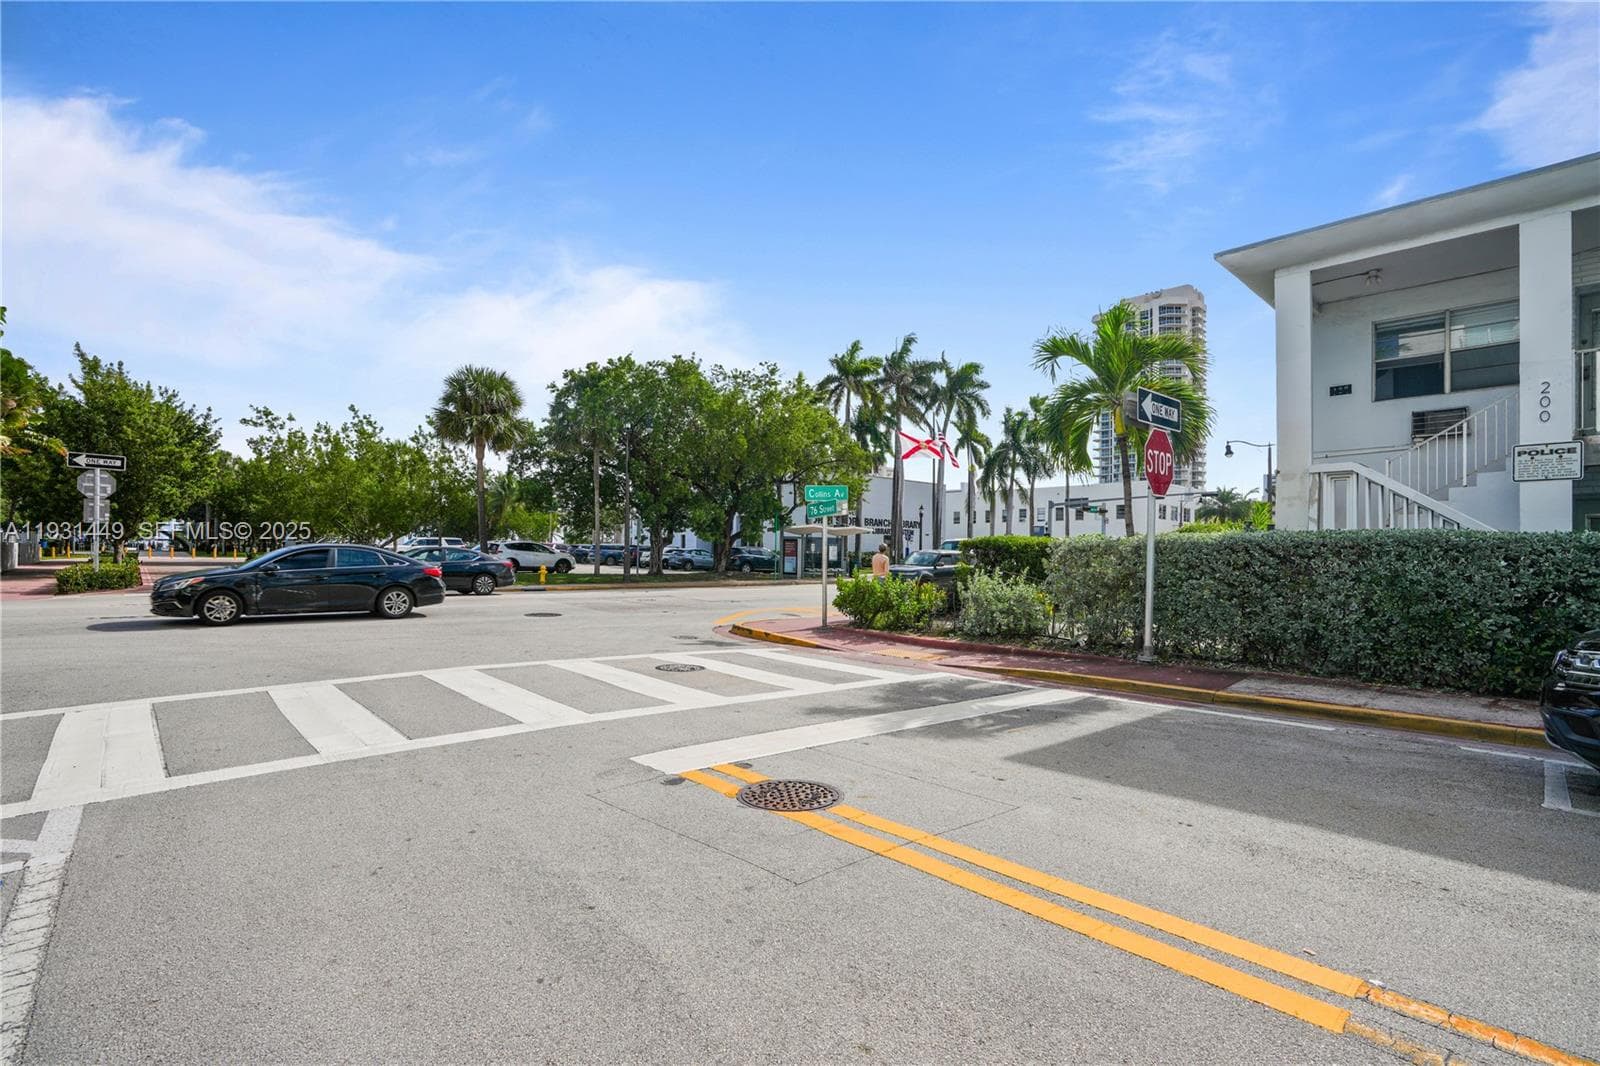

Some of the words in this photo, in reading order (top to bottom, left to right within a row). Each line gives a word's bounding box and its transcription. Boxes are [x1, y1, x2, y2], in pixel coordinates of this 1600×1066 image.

[1539, 381, 1551, 423] 200
[1151, 403, 1164, 415] ONE
[1164, 406, 1176, 419] WAY
[1517, 447, 1578, 457] POLICE
[1146, 449, 1172, 475] STOP
[808, 488, 831, 498] Collins
[809, 506, 818, 515] 76
[818, 504, 835, 514] Street
